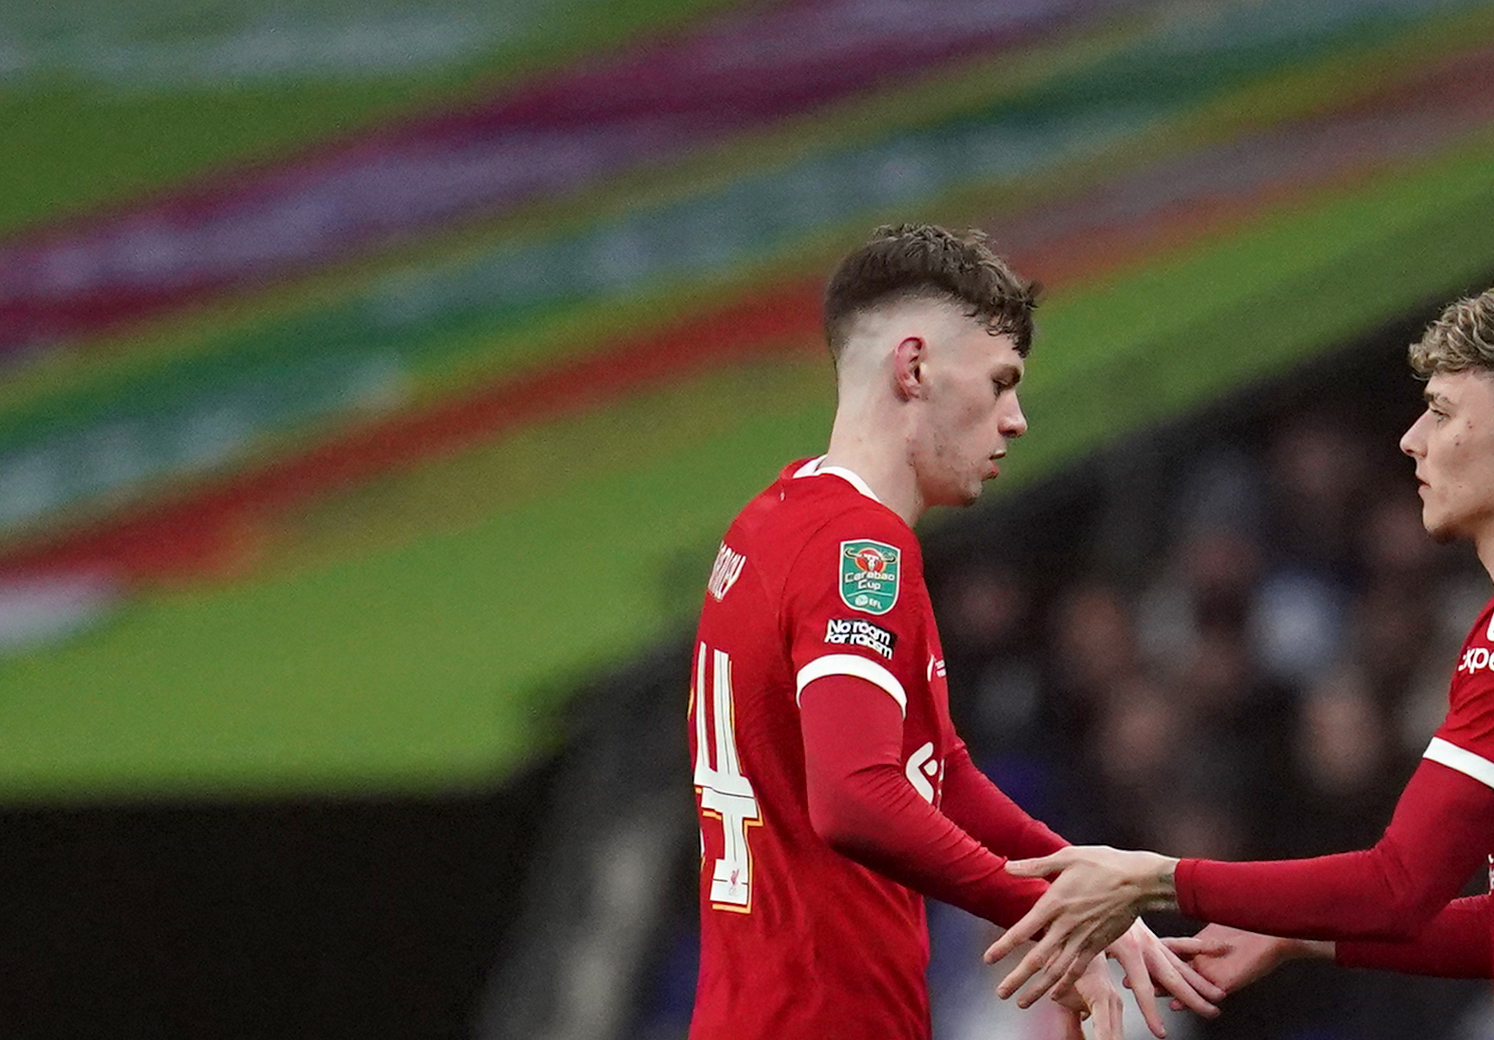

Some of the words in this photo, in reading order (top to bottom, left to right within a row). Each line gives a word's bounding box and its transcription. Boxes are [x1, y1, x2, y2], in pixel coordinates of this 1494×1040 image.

[844, 571, 896, 583] Carabao
[858, 579, 881, 591] Cup
[828, 619, 851, 634] No
[852, 621, 891, 645] room
[824, 633, 850, 644] for
